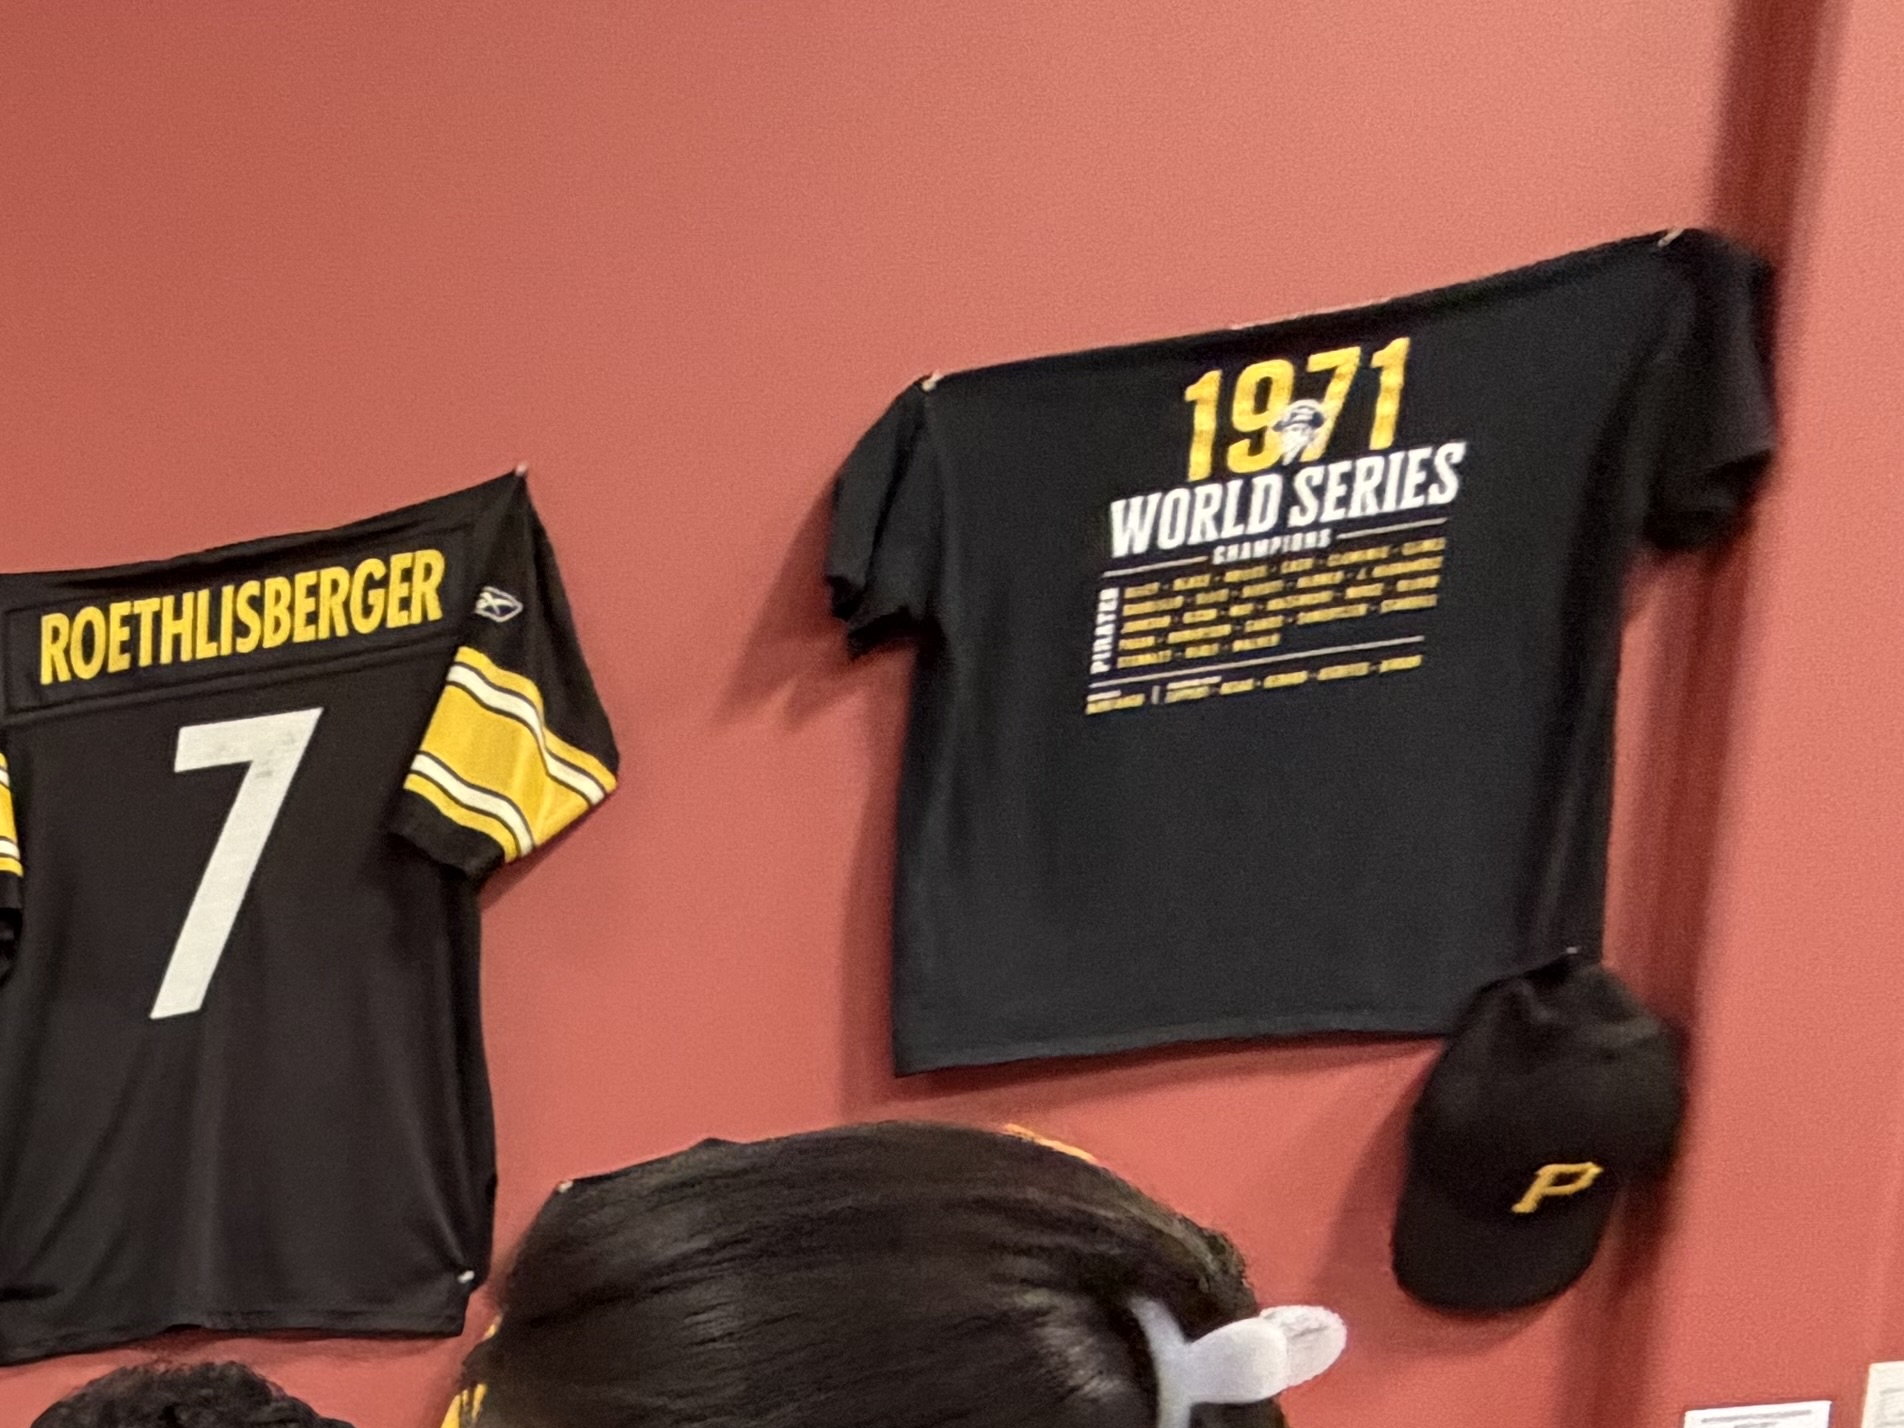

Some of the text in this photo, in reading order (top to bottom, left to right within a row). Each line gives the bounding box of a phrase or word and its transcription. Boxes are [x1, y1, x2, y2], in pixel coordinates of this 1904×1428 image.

[1184, 337, 1411, 482] 1971
[1110, 441, 1467, 558] WORLD SERIES
[1212, 528, 1332, 565] CHAMPIONS
[40, 549, 447, 686] ROETHLISBERGER
[149, 707, 324, 1021] 7
[1510, 1161, 1604, 1213] P
